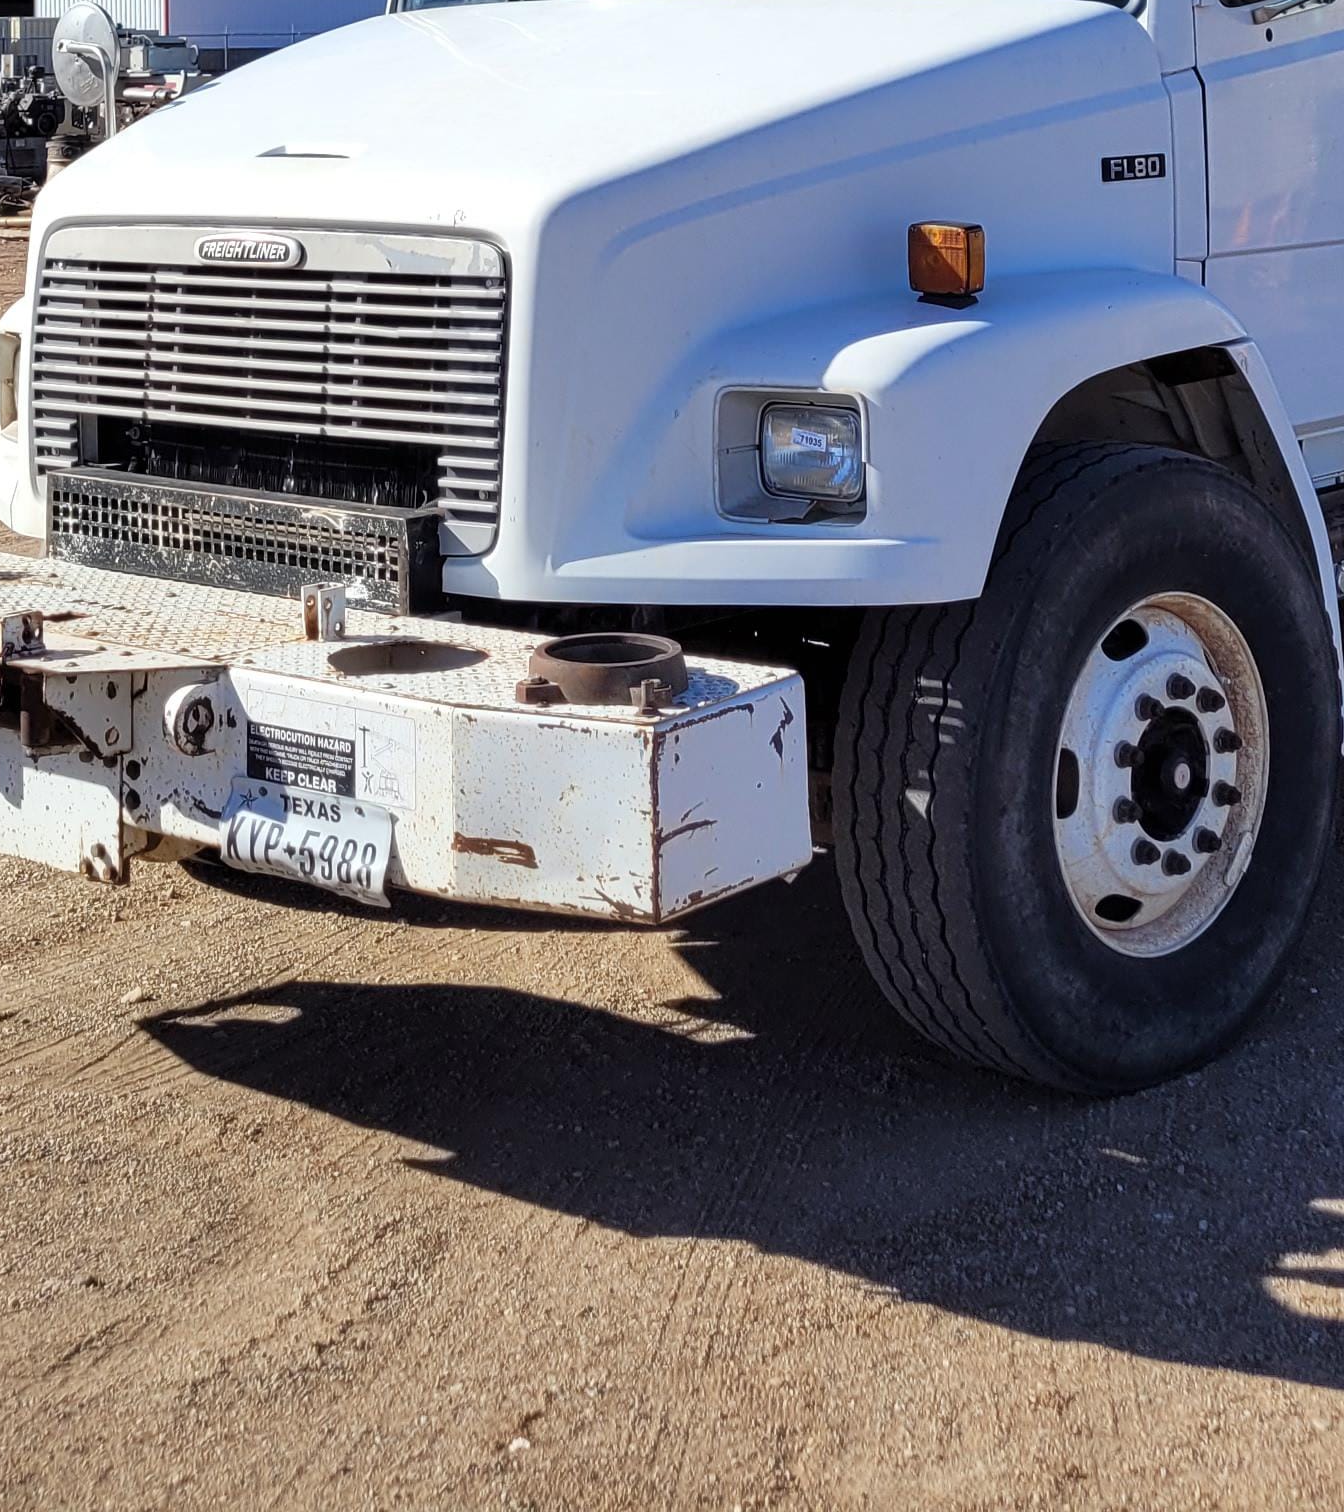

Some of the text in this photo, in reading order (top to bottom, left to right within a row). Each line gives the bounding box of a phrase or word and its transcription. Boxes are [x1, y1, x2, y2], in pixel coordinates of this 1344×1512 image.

[1110, 157, 1160, 179] FL80
[202, 241, 286, 259] FREIGHTLINER
[250, 724, 316, 747] ELECTROCUTION
[317, 737, 352, 753] HAZARD
[265, 767, 336, 793] KEEP CLEAR
[280, 794, 341, 823] TEXAS
